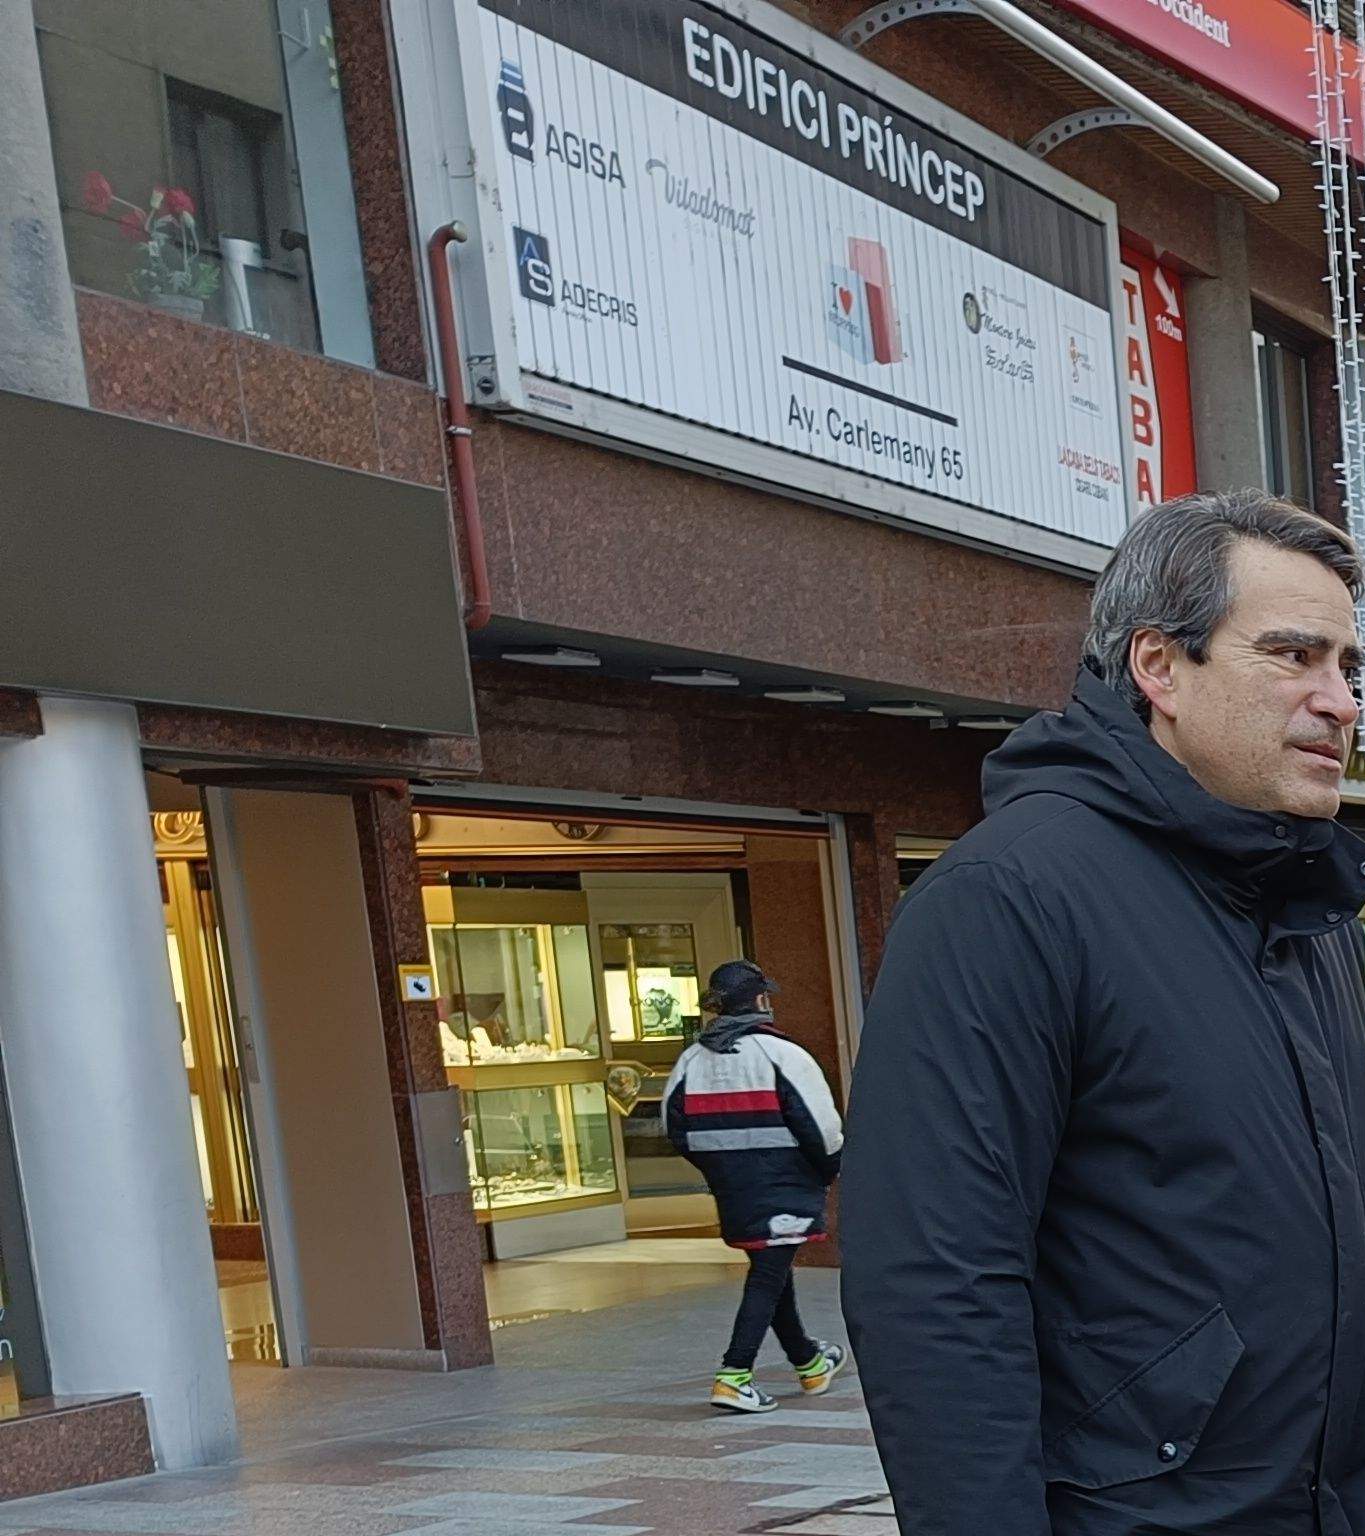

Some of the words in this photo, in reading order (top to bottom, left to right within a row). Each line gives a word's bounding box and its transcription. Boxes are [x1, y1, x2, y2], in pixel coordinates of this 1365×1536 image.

[545, 123, 626, 189] AGISA
[683, 17, 831, 148] EDIFICI
[837, 102, 985, 222] PRÍNCEP
[561, 279, 639, 327] ADECRIS
[788, 394, 821, 435] Av.
[827, 407, 937, 479] Carlemany
[941, 446, 964, 481] 65
